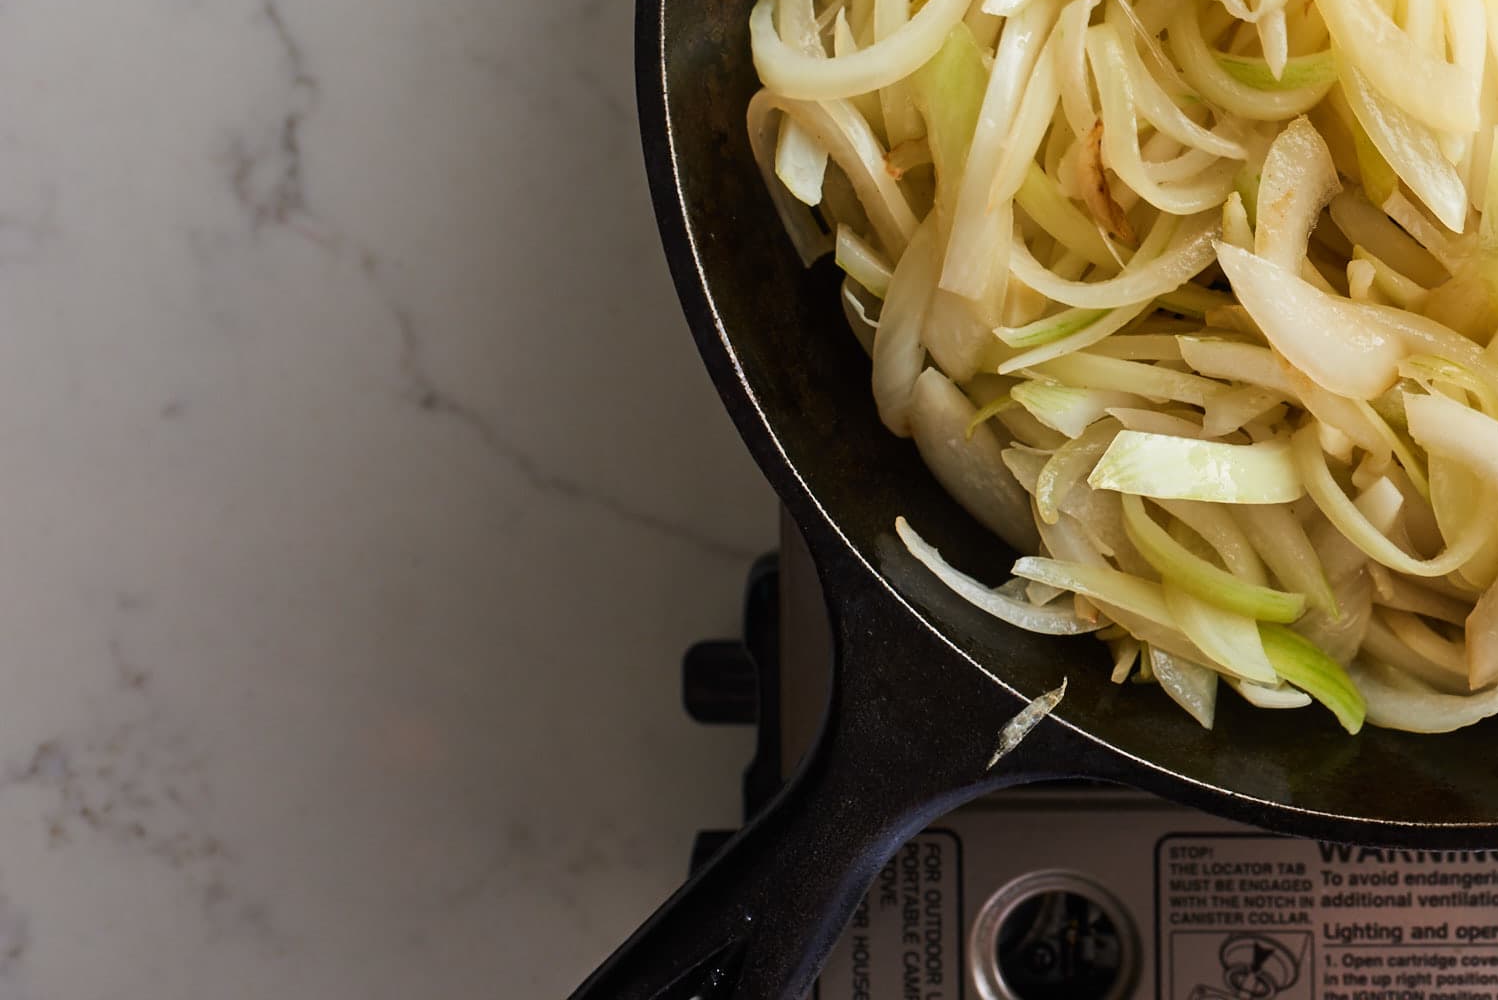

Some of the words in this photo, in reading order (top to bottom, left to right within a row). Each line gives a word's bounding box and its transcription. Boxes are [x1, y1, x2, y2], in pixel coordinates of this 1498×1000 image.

[1169, 846, 1213, 859] STOP!
[925, 843, 941, 881] FOR
[1168, 862, 1198, 876] THE
[1202, 862, 1273, 876] LOCATOR
[1277, 862, 1306, 876] TAB
[1169, 879, 1211, 892] MUST
[1214, 879, 1235, 892] BE
[1238, 879, 1313, 892] ENGAGED
[1320, 870, 1343, 886] To
[1348, 870, 1399, 887] avoid
[902, 843, 920, 943] PORTABLE
[1320, 891, 1412, 908] additional
[1169, 895, 1207, 908] WITH
[1210, 895, 1240, 909] THE
[1243, 895, 1296, 909] NOTCH
[1299, 896, 1315, 908] IN
[1169, 911, 1244, 925] CANISTER
[1248, 911, 1312, 925] COLLAR.
[925, 890, 942, 985] OUTDOOR
[1323, 922, 1403, 941] Lighting
[1410, 922, 1449, 940] and
[1324, 954, 1337, 968] 1.
[1341, 954, 1384, 970] Open
[1386, 953, 1458, 969] cartridge
[1324, 973, 1339, 986] in
[1342, 973, 1368, 986] the
[1371, 974, 1392, 987] up
[1395, 972, 1432, 987] right
